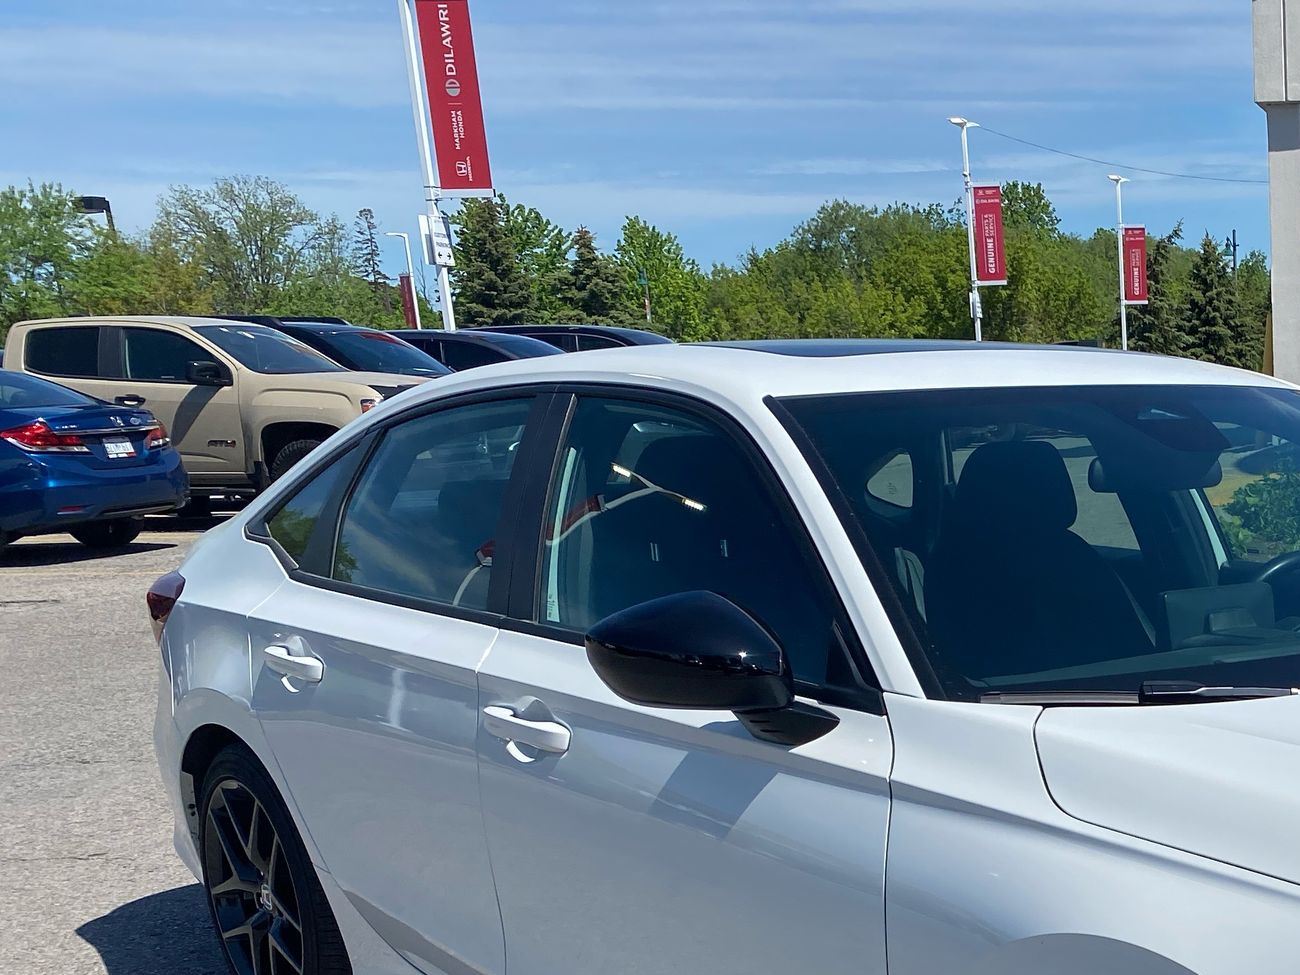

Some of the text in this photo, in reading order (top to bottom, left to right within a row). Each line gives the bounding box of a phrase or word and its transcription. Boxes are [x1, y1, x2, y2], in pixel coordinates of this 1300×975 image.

[437, 3, 457, 76] DILAWRI
[451, 110, 461, 150] MARKHAM
[457, 110, 465, 139] HONDA
